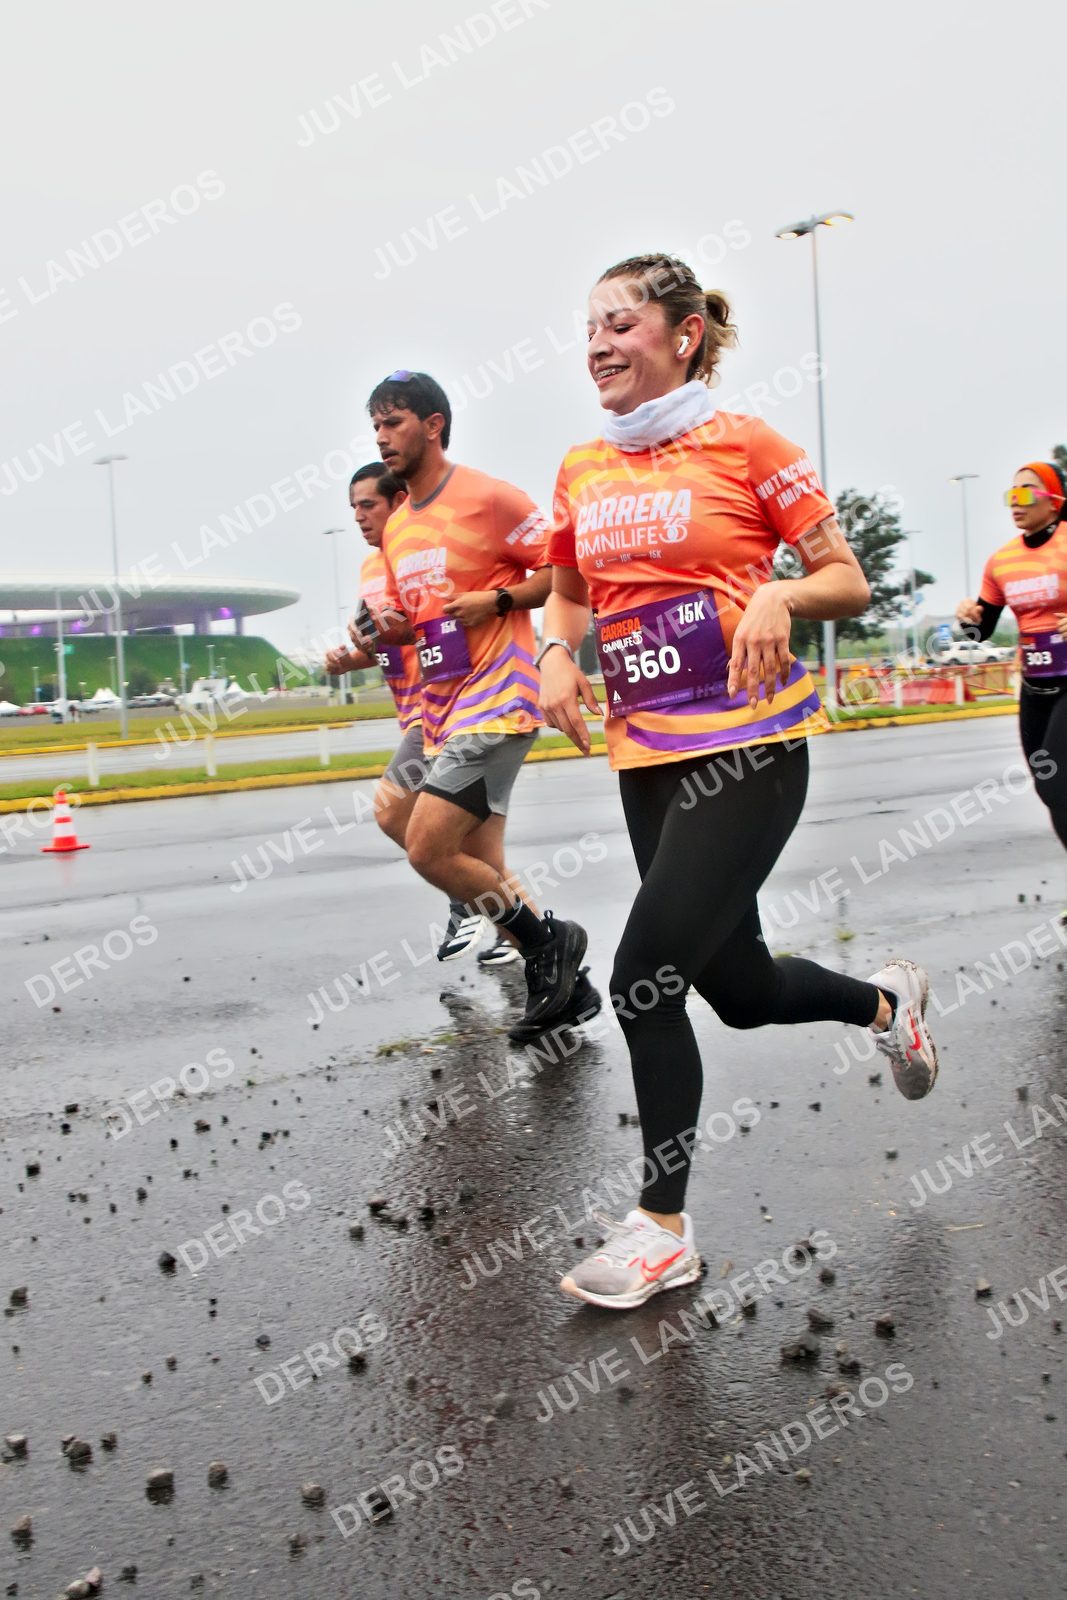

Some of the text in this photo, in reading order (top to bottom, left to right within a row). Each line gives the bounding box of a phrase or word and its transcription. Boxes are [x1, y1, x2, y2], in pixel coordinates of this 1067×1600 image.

[575, 489, 692, 536] CARRERA
[576, 526, 658, 559] OMNILIFE
[648, 550, 662, 559] 15K
[677, 600, 706, 625] 15K
[601, 617, 641, 642] CARRERA
[602, 636, 634, 653] OMNILIFE
[624, 645, 681, 684] 560
[1026, 651, 1052, 666] 303
